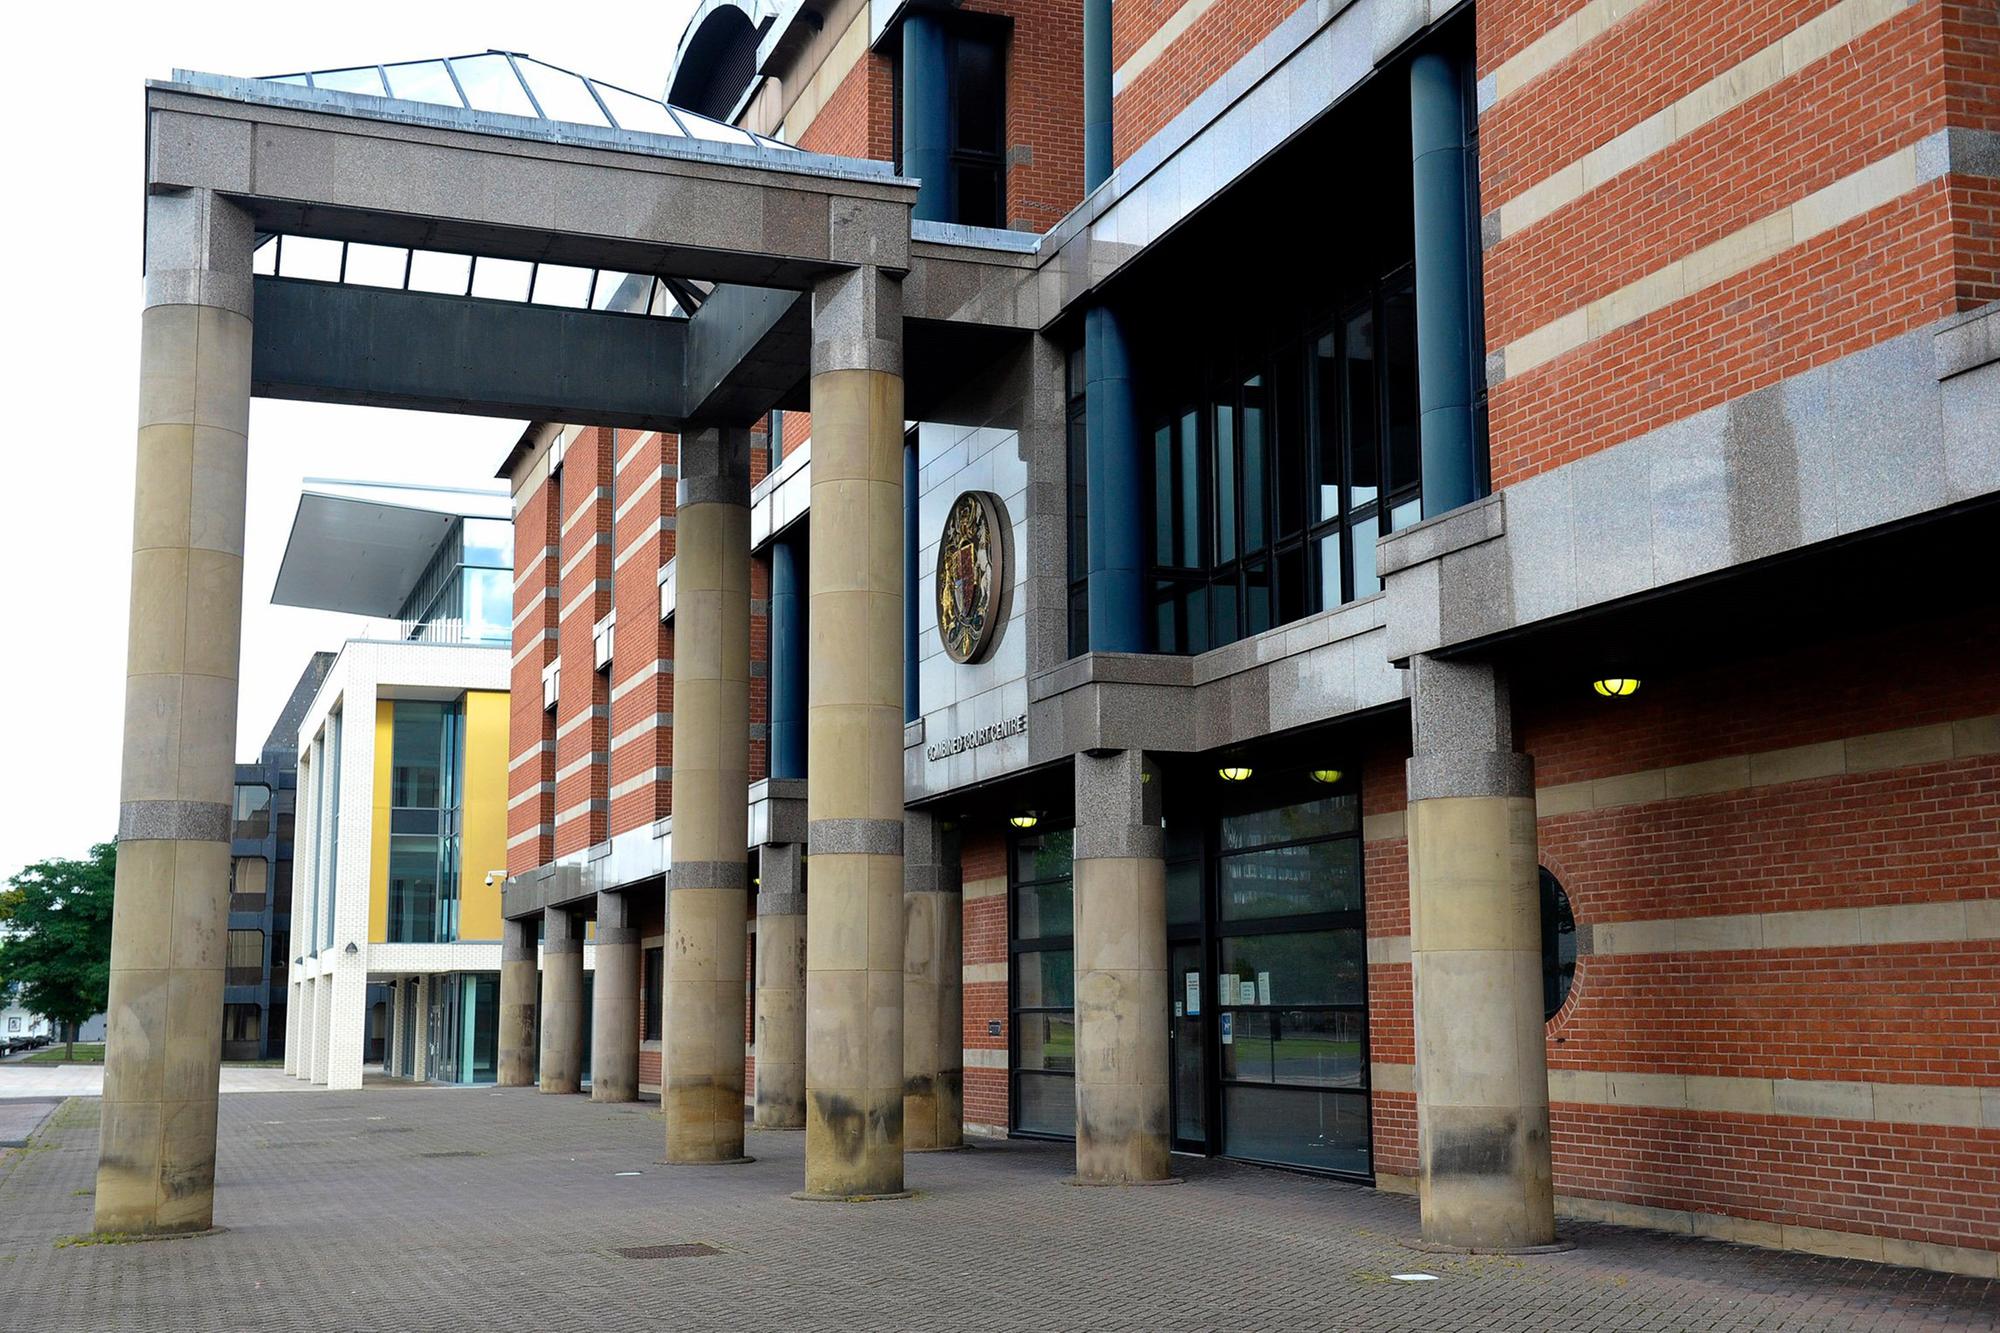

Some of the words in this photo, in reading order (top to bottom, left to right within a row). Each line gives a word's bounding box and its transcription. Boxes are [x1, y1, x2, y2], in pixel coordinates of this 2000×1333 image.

[927, 735, 963, 761] COMBINED
[964, 726, 991, 749] COURT
[991, 714, 1027, 742] CENTRE
